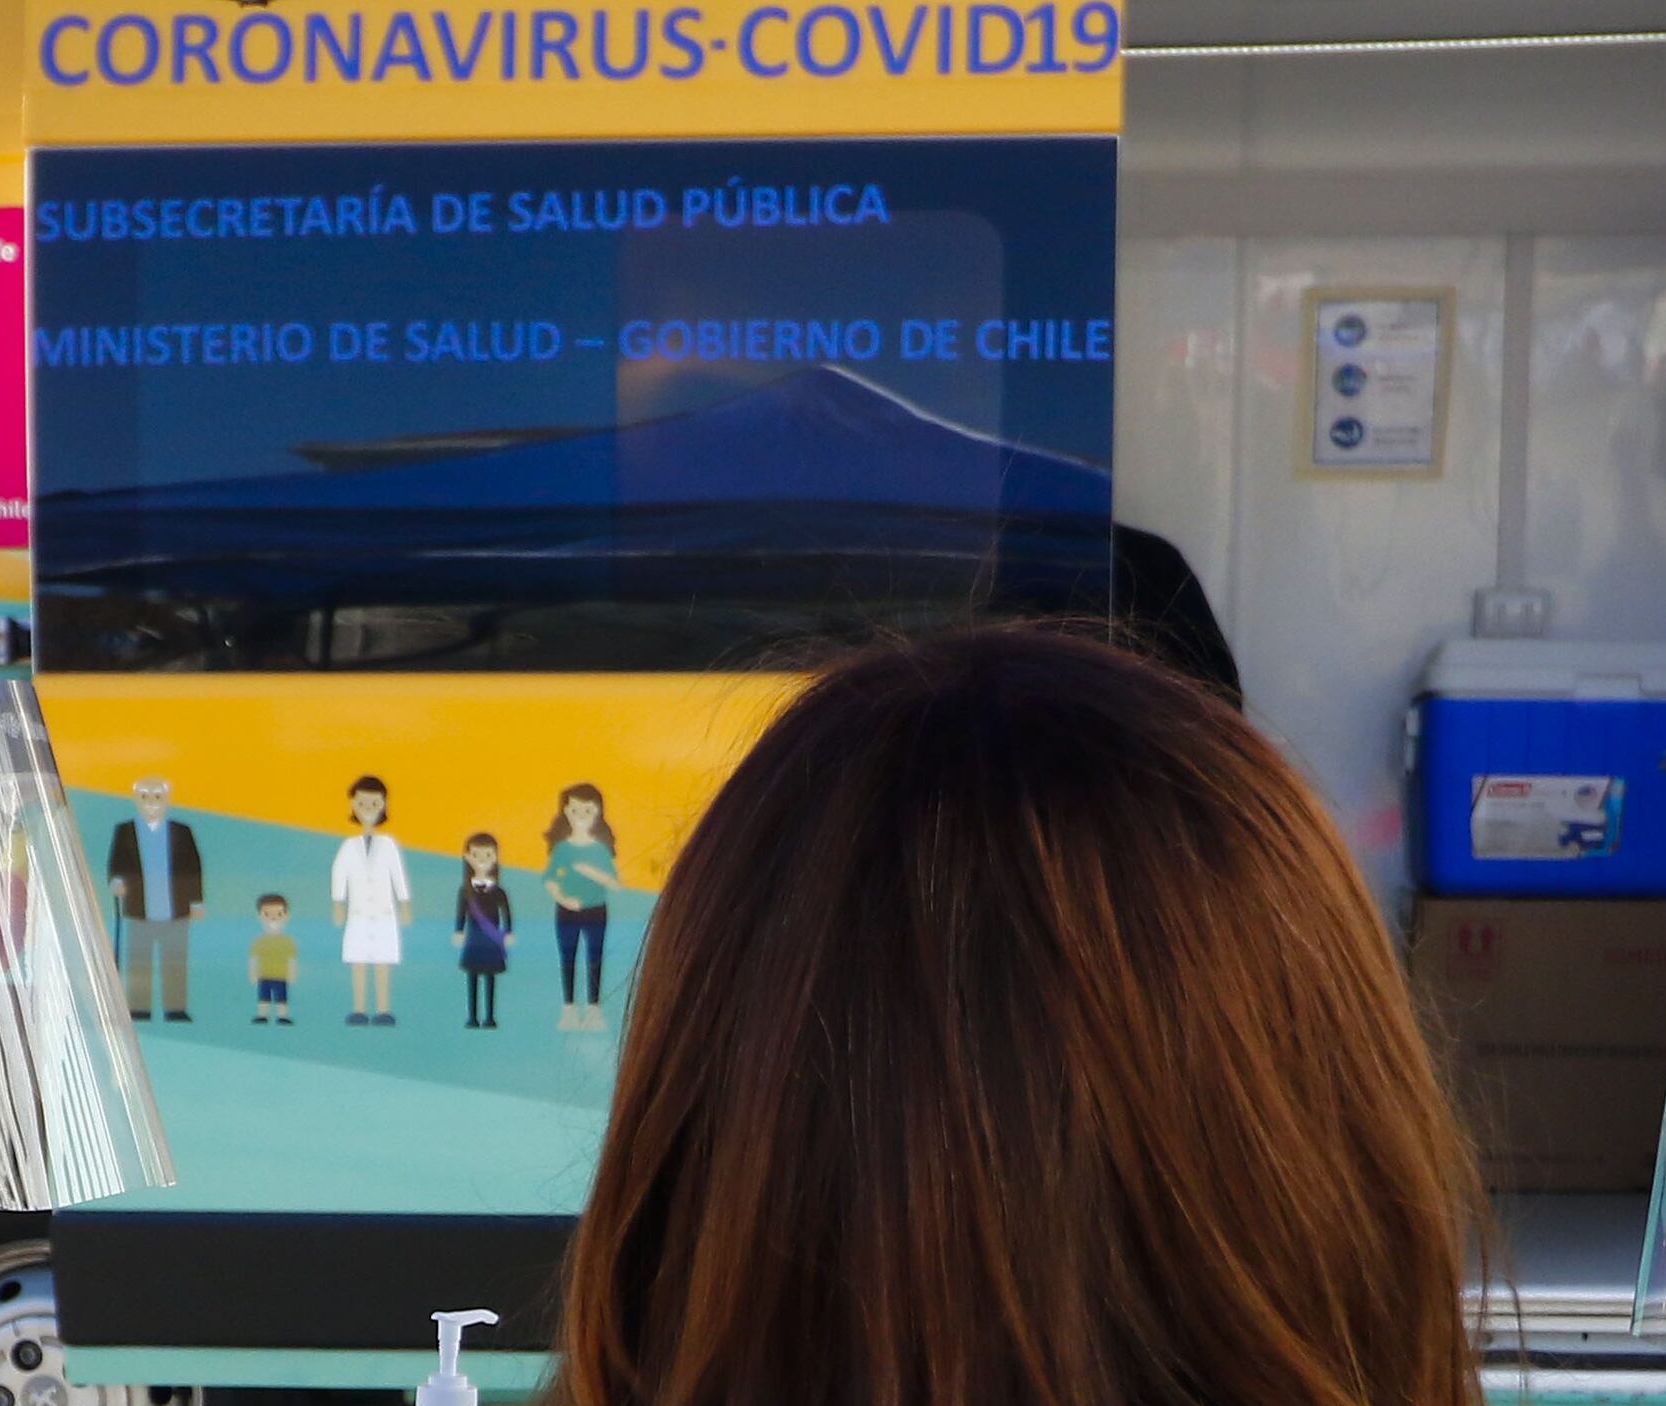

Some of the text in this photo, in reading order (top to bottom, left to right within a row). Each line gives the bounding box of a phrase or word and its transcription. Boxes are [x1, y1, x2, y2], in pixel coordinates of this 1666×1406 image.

[36, 177, 893, 243] SUBSECRETARÍA DE SALUD PÚBLICA
[34, 323, 316, 367] MINISTERIO
[329, 323, 393, 364] DE
[406, 321, 565, 364] SALUD
[618, 320, 885, 362] GOBIERNO
[900, 320, 961, 361] DE
[975, 319, 1112, 361] CHILE
